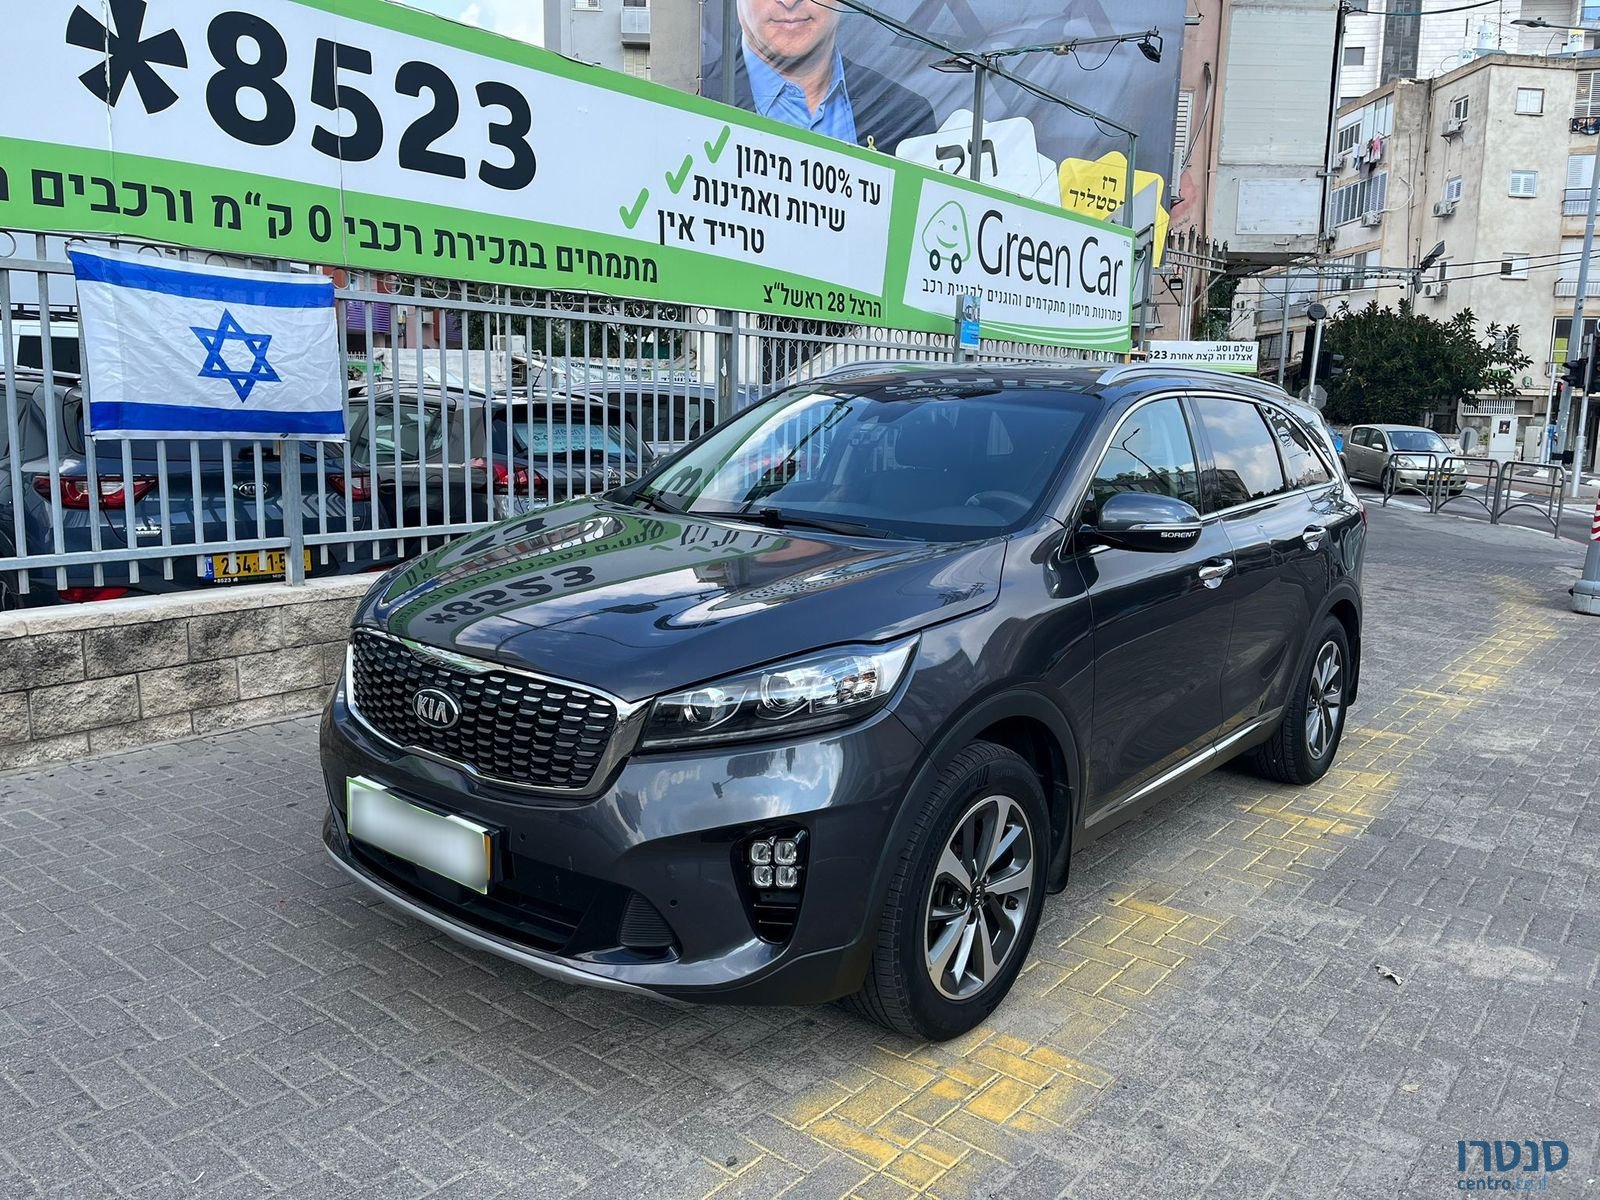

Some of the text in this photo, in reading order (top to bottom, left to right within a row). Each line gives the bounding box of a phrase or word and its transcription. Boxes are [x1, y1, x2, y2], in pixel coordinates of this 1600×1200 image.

[736, 144, 881, 206] עד 100% מימון
[1102, 175, 1117, 193] רז
[31, 168, 194, 224] ורכבים
[693, 174, 845, 232] שירות ואמינות
[1069, 187, 1126, 213] סטליך
[308, 204, 332, 243] 0
[344, 216, 423, 255] רכבי
[657, 209, 765, 254] טרייד אין
[433, 228, 547, 270] במכירת
[977, 209, 1124, 298] Green Car
[556, 245, 659, 284] מתמחים
[922, 278, 943, 294] רכב
[987, 289, 1022, 307] והוגנים
[827, 290, 846, 314] 28
[849, 293, 882, 319] הרצל
[1025, 295, 1066, 315] מתקדמים
[1068, 302, 1090, 318] מימון
[1092, 306, 1122, 322] פתרונות
[1170, 352, 1194, 360] אחרת
[1195, 353, 1214, 362] קצת
[1216, 353, 1227, 361] זה
[1228, 352, 1253, 361] אצלנו
[1233, 344, 1253, 353] שלם
